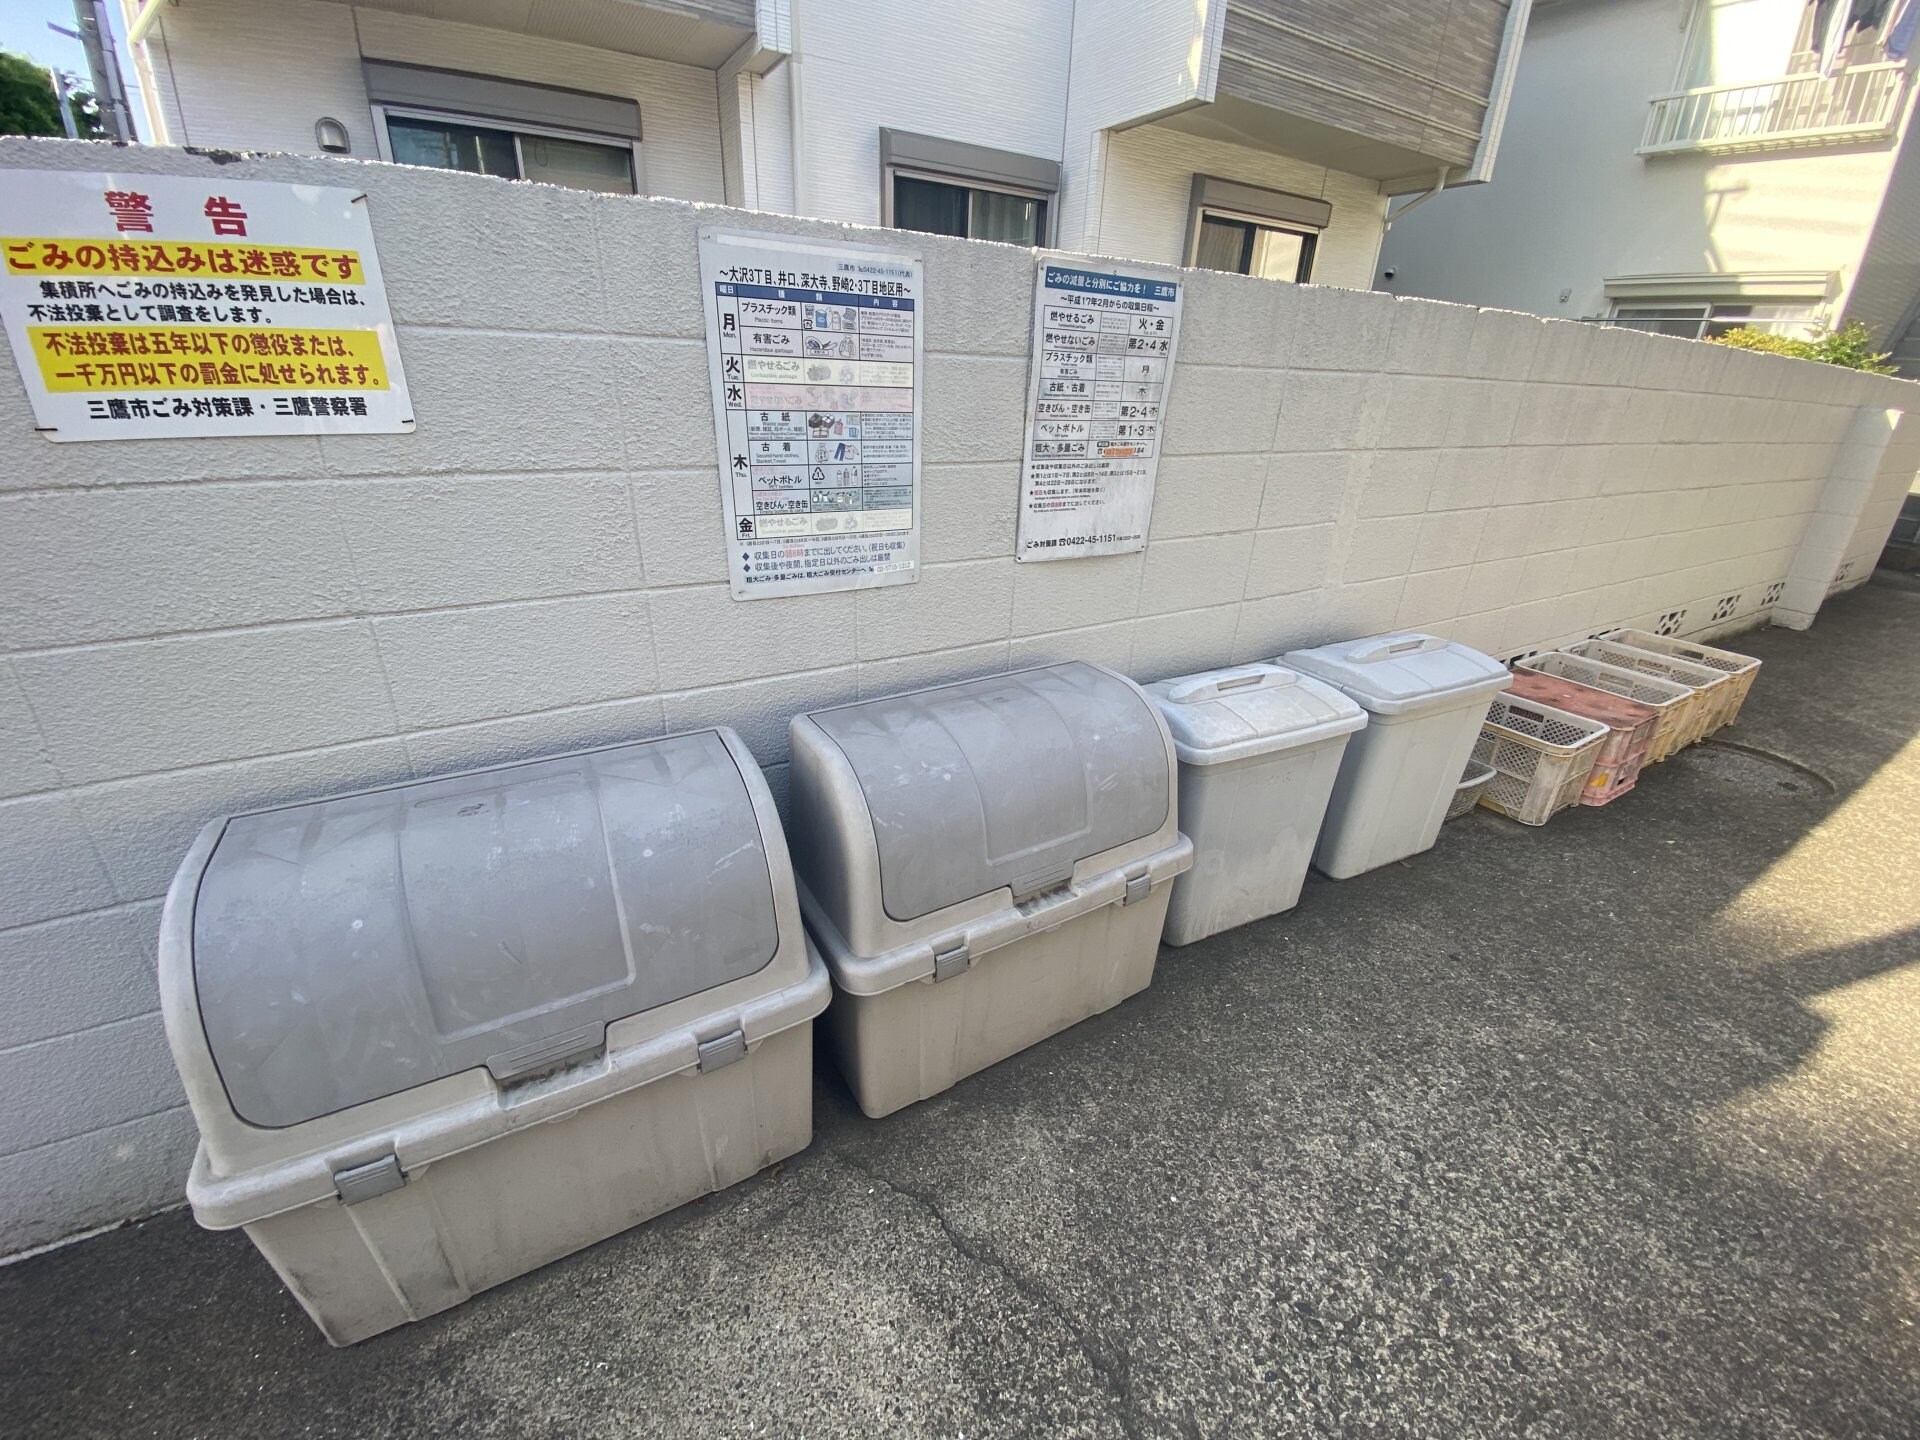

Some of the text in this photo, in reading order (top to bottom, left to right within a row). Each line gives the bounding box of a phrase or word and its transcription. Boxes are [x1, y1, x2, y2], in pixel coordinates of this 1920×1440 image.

[8, 241, 358, 279] ごみの持込みは迷惑です
[39, 280, 366, 306] 集積所へごみの持込みを発見した場合は、
[27, 304, 272, 324] 不法投棄として調査をします。
[741, 302, 797, 316] プラスチック類
[723, 313, 736, 331] 月
[42, 331, 355, 357] 不法投棄は五年以下の懲役または、
[753, 333, 790, 345] 有害ごみ
[725, 356, 740, 373] 火
[56, 361, 379, 387] 一千万円以下の罰金に処せられます。
[727, 384, 742, 401] 水
[87, 396, 368, 421] 三鷹市ごみ対策課・三鷹警察署
[733, 454, 748, 470] 木
[738, 517, 753, 533] 金
[1067, 534, 1116, 546] 0422-45-1151
